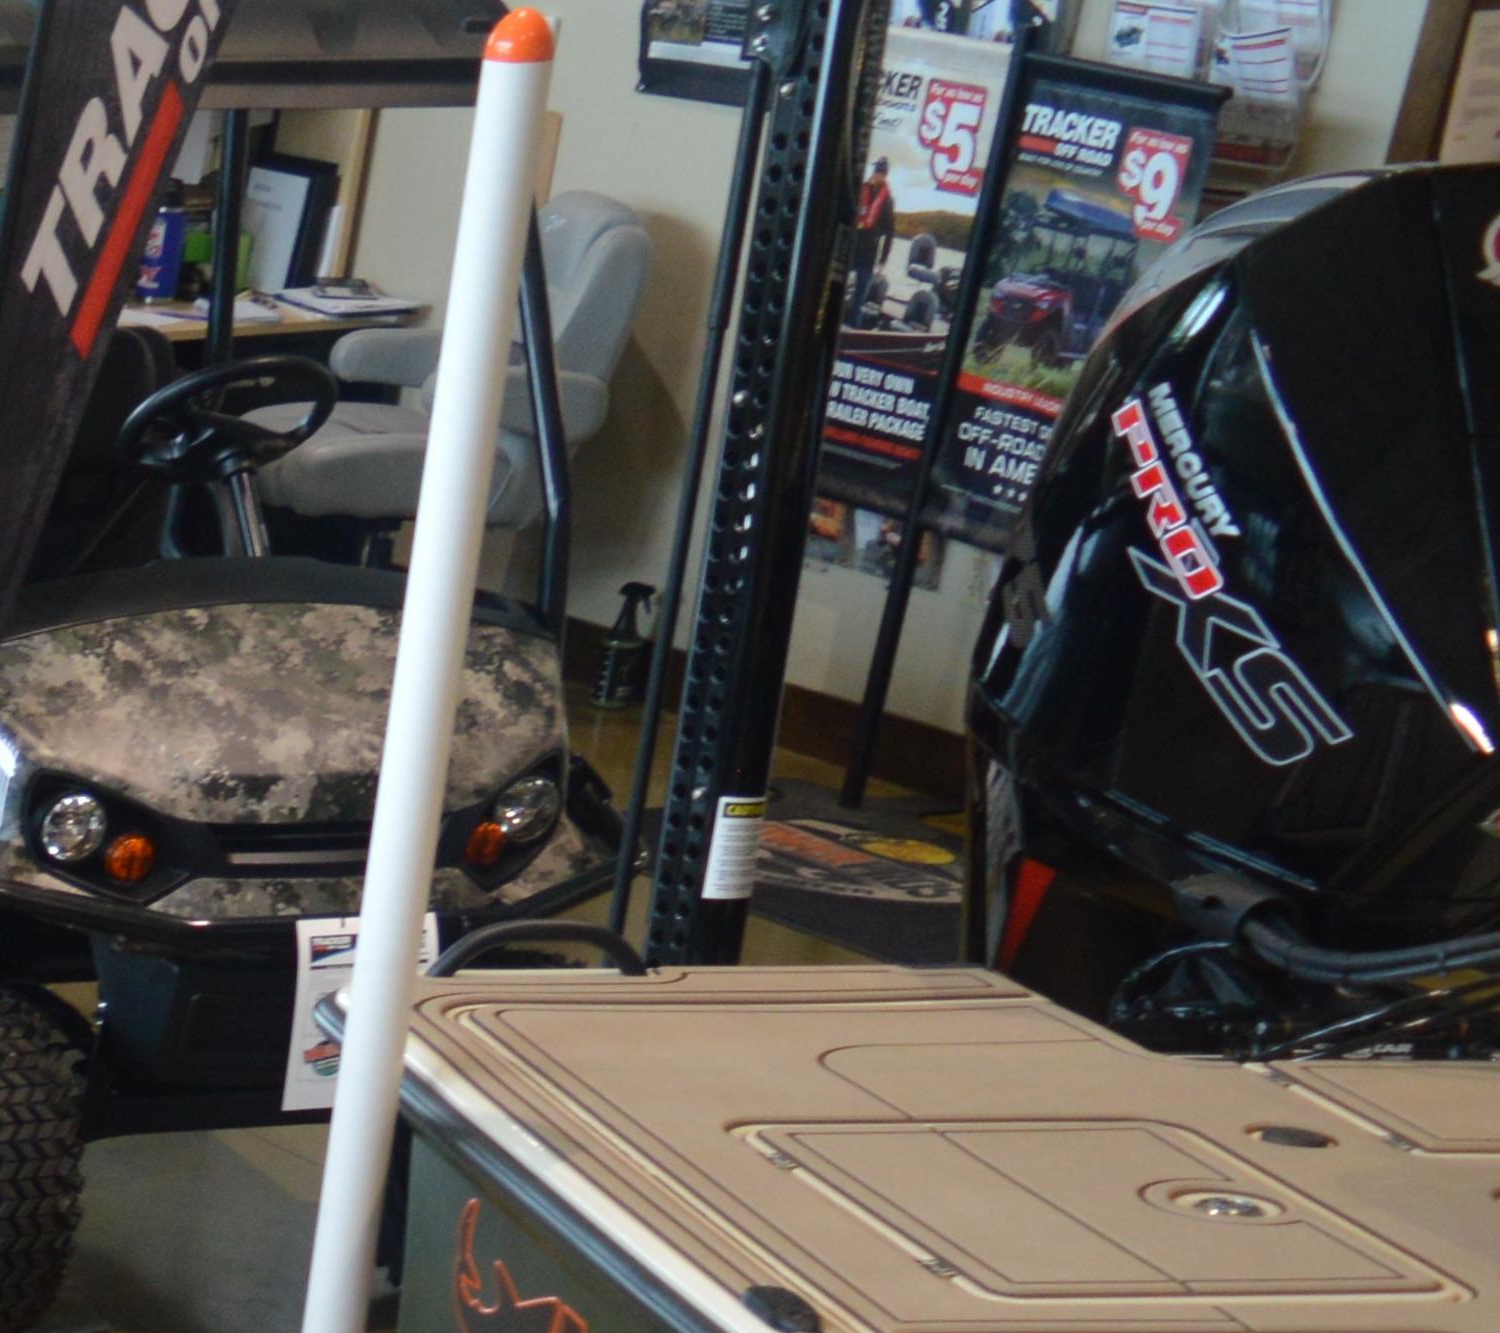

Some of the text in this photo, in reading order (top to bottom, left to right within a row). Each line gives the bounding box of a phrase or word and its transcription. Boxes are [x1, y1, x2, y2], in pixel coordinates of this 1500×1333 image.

[921, 98, 982, 183] $5
[1021, 103, 1123, 150] TRACKER
[1119, 148, 1179, 227] $9
[963, 446, 987, 471] IN
[973, 405, 1040, 435] FASTEST
[1149, 382, 1241, 538] MERCURY
[1111, 399, 1224, 600] PRO
[1126, 545, 1355, 767] XS
